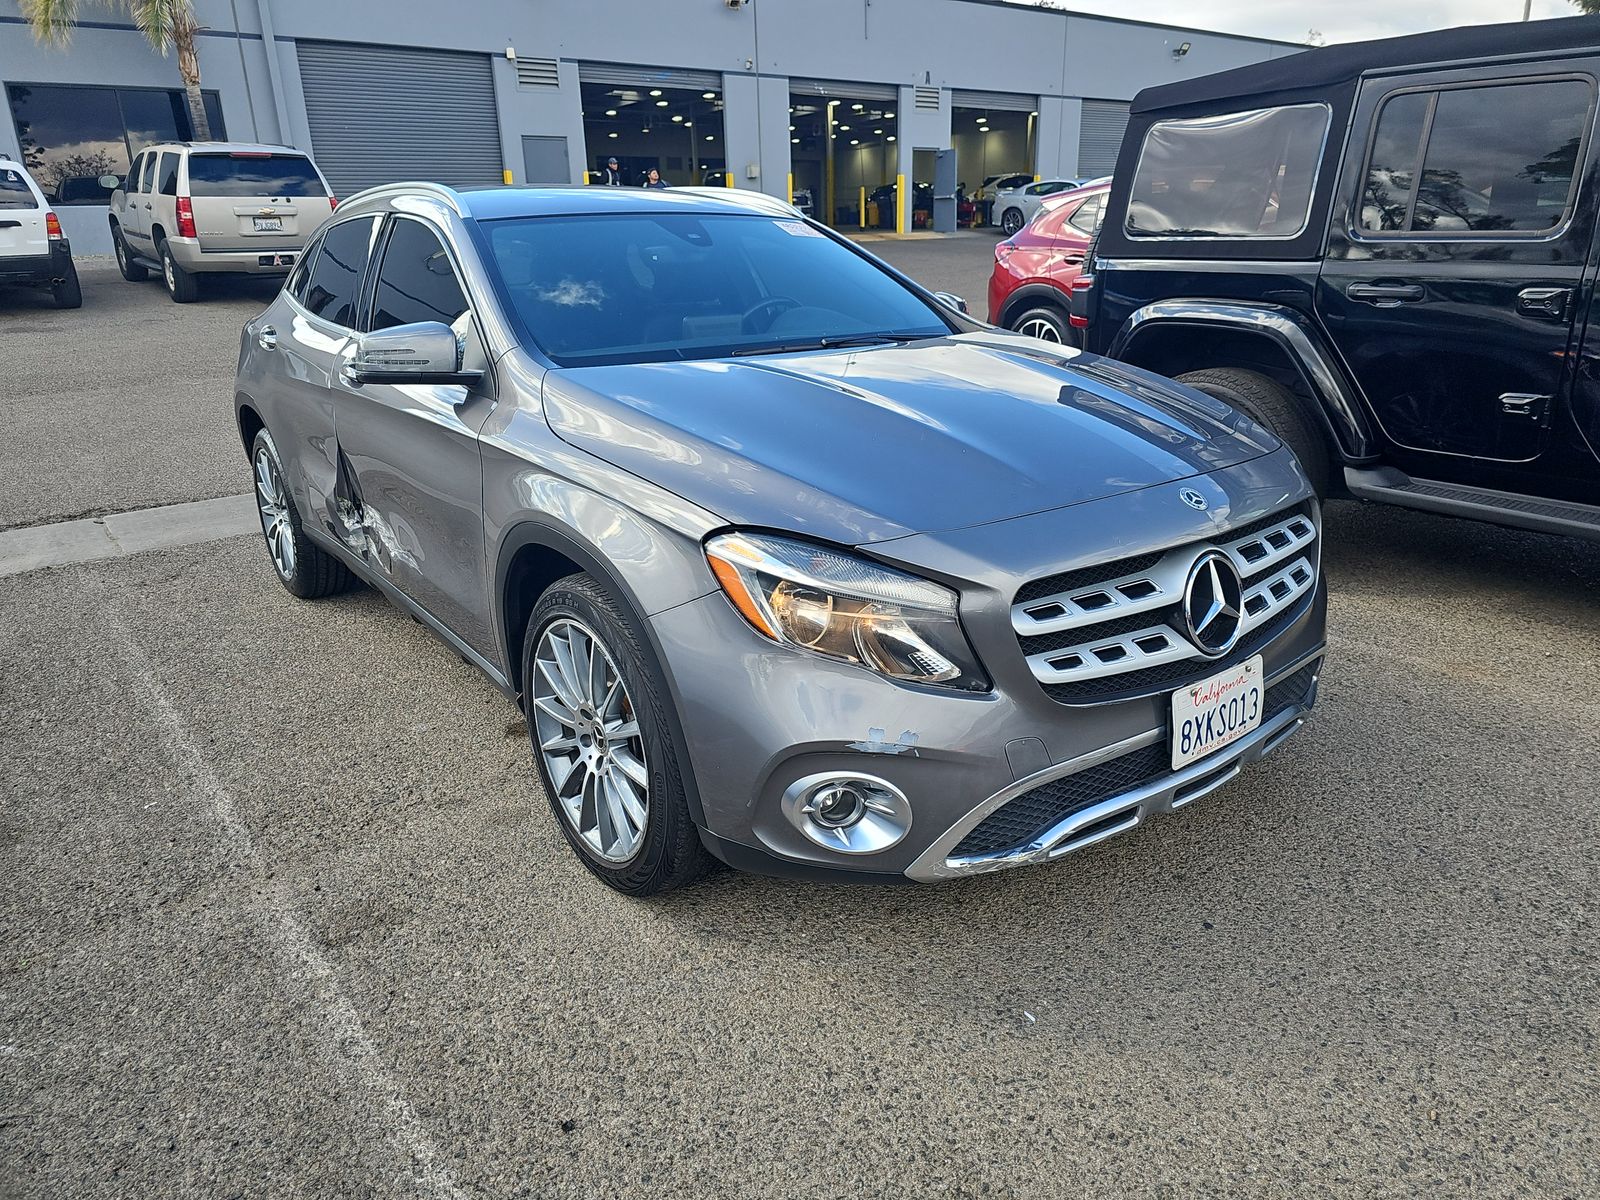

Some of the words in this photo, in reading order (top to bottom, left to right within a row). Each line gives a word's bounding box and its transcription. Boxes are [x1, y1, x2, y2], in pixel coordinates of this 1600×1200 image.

[1193, 675, 1248, 707] California
[1180, 687, 1259, 755] 8XKS013
[1196, 729, 1244, 755] dmv.ca.gov
